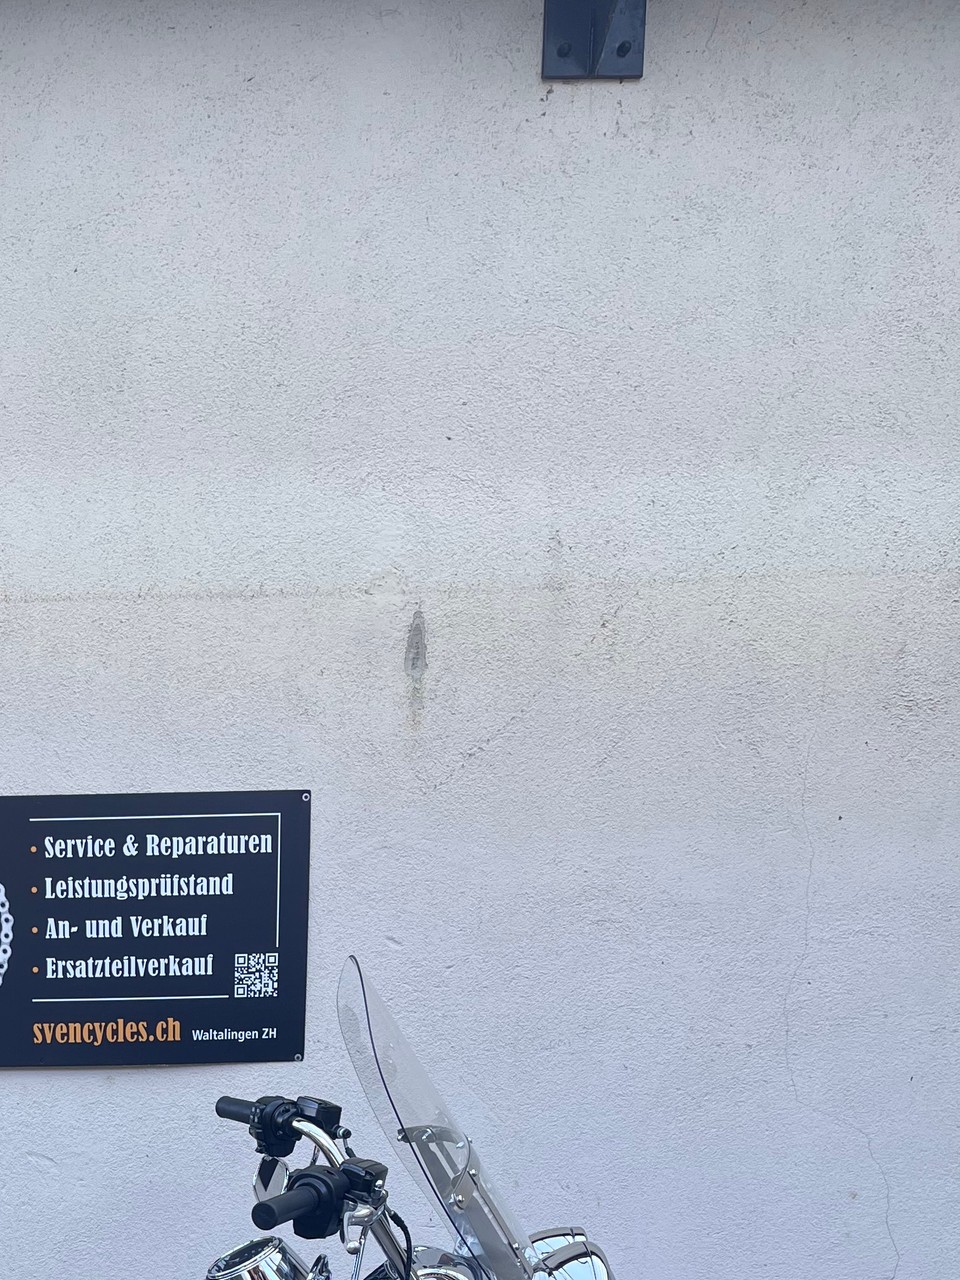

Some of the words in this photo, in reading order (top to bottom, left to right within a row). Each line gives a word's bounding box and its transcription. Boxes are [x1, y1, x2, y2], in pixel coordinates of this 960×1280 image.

[44, 834, 116, 858] Service
[122, 833, 139, 857] &
[146, 832, 273, 859] Reparaturen
[44, 873, 234, 900] Leistungsprüfstand
[45, 917, 79, 939] An-
[85, 916, 123, 938] und
[129, 914, 208, 937] Verkauf
[45, 954, 214, 979] Ersatzteilverkauf
[32, 1017, 182, 1047] svencycles.ch
[191, 1028, 259, 1043] Waltalingen
[262, 1027, 277, 1039] ZH
